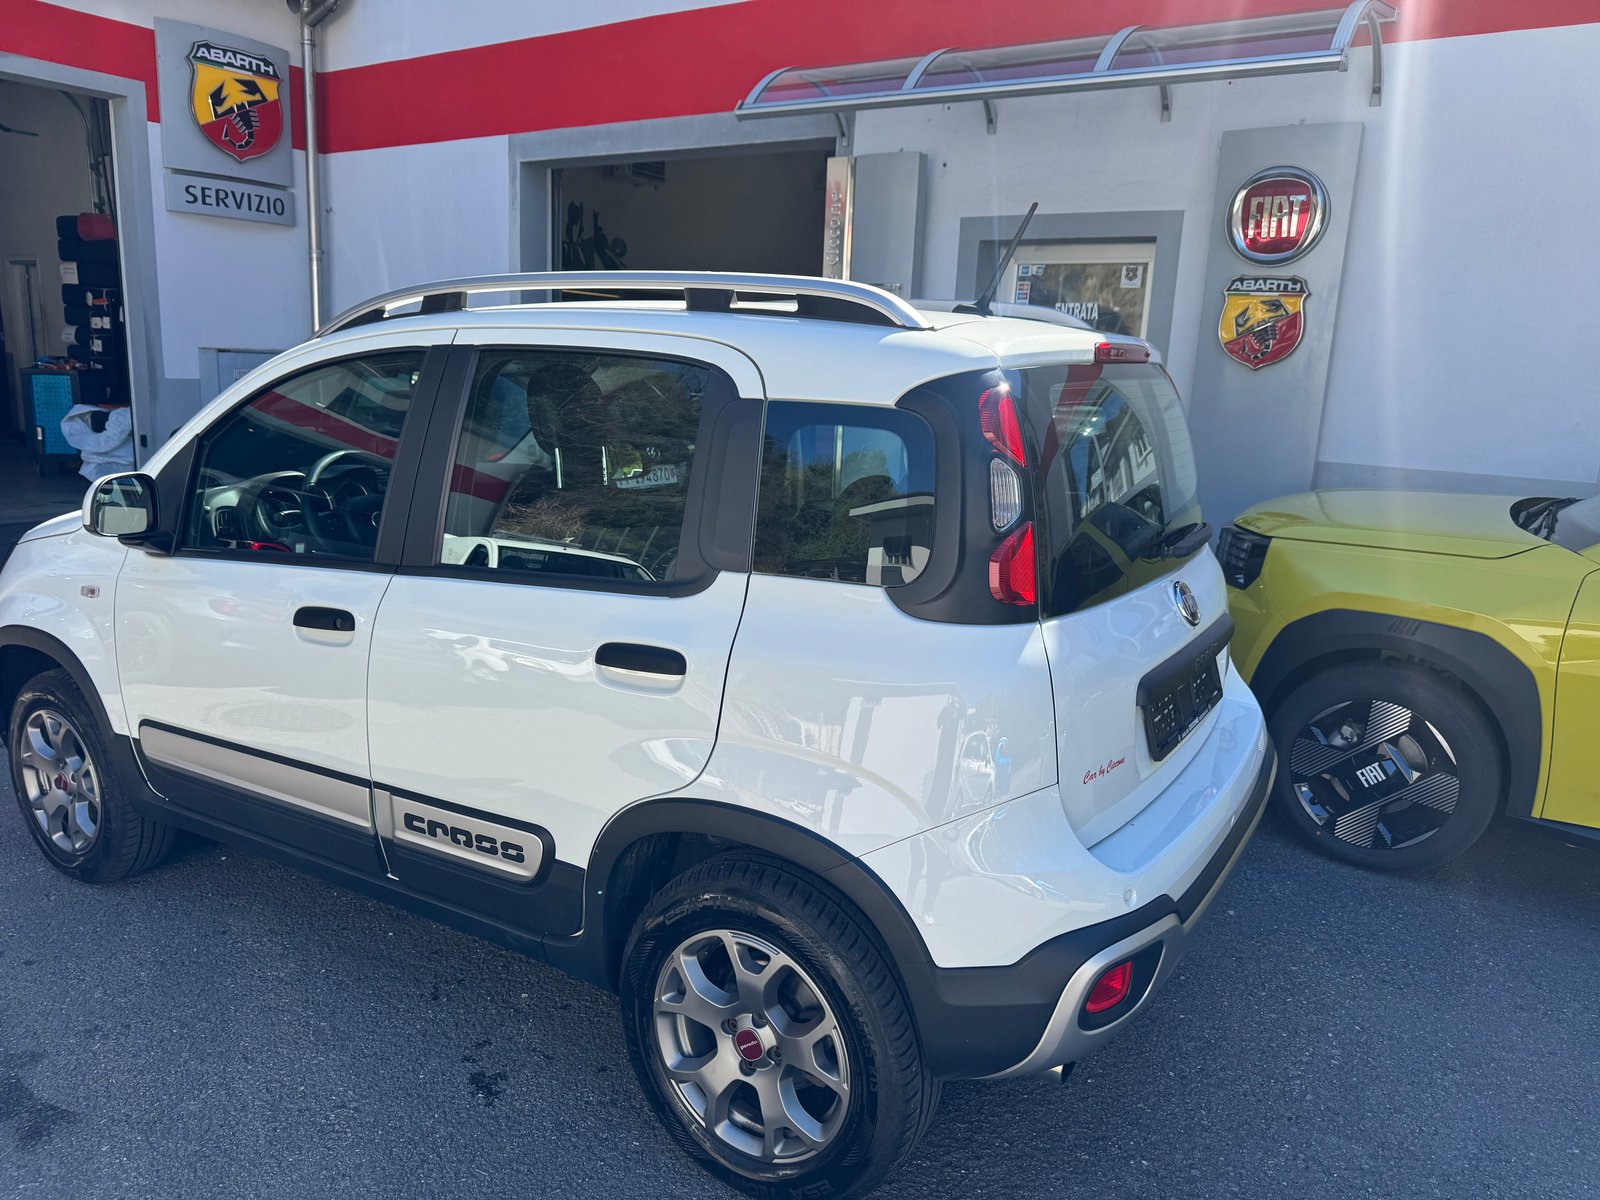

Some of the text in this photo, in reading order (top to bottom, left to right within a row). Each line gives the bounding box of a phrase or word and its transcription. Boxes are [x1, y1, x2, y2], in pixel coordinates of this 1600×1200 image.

[195, 47, 274, 76] ABARTH
[184, 184, 285, 216] SERVIZIO
[1247, 194, 1308, 239] FIAT
[1230, 279, 1301, 292] ABARTH
[1083, 769, 1097, 784] Car
[1098, 764, 1106, 778] by
[1355, 761, 1386, 788] FIAT
